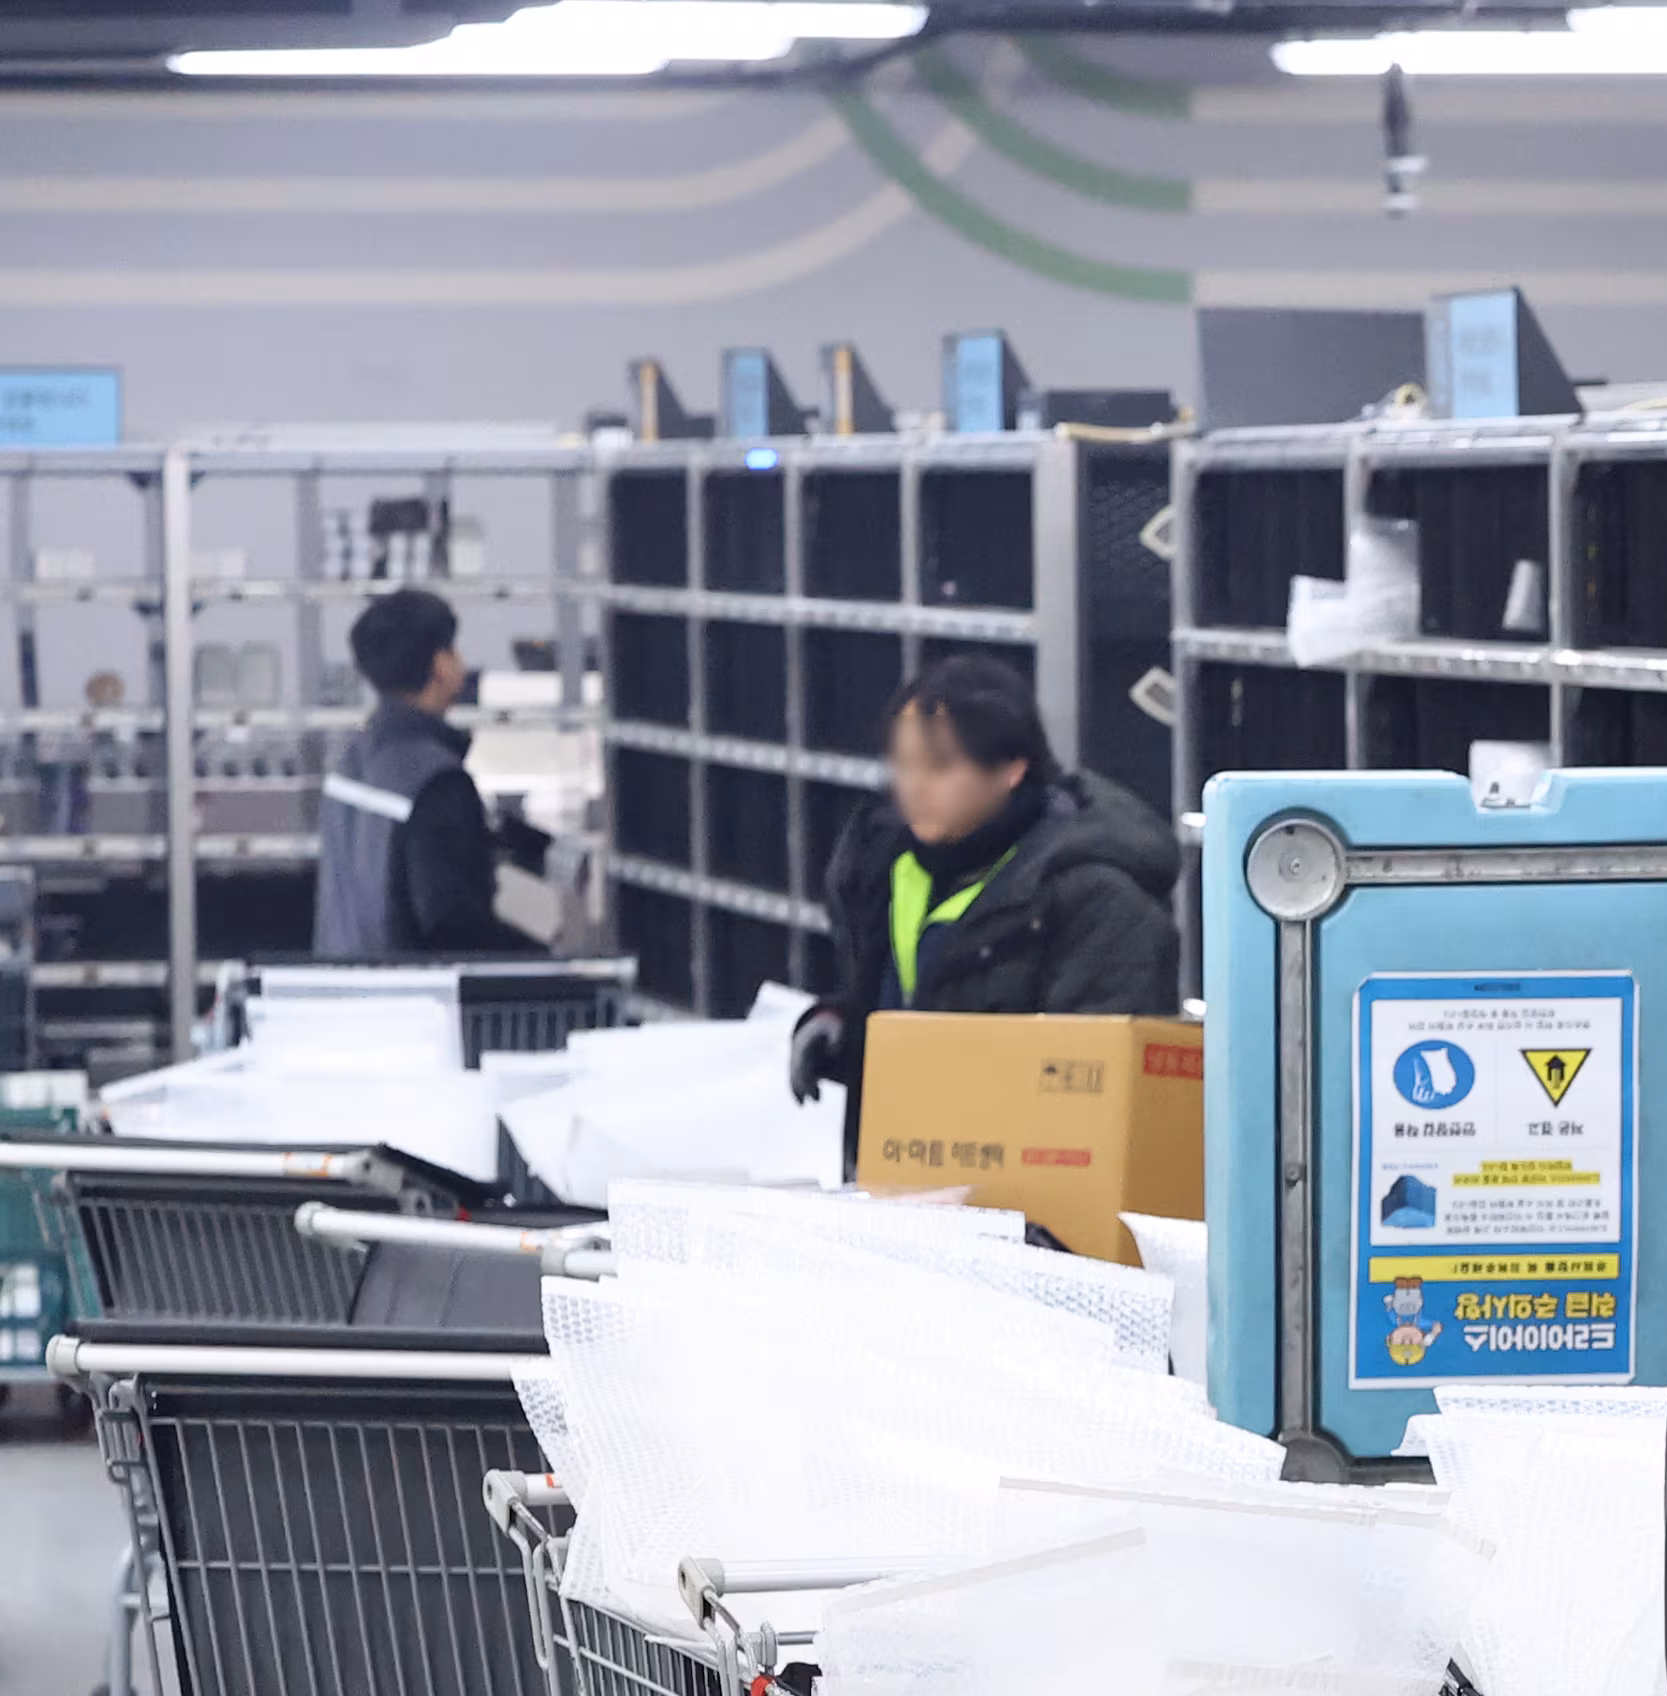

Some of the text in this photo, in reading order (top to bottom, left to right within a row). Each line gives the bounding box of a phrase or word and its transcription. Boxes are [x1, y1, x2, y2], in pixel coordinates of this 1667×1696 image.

[1454, 1291, 1616, 1320] 취급 주의사항
[1463, 1323, 1616, 1352] 드라이아이스
